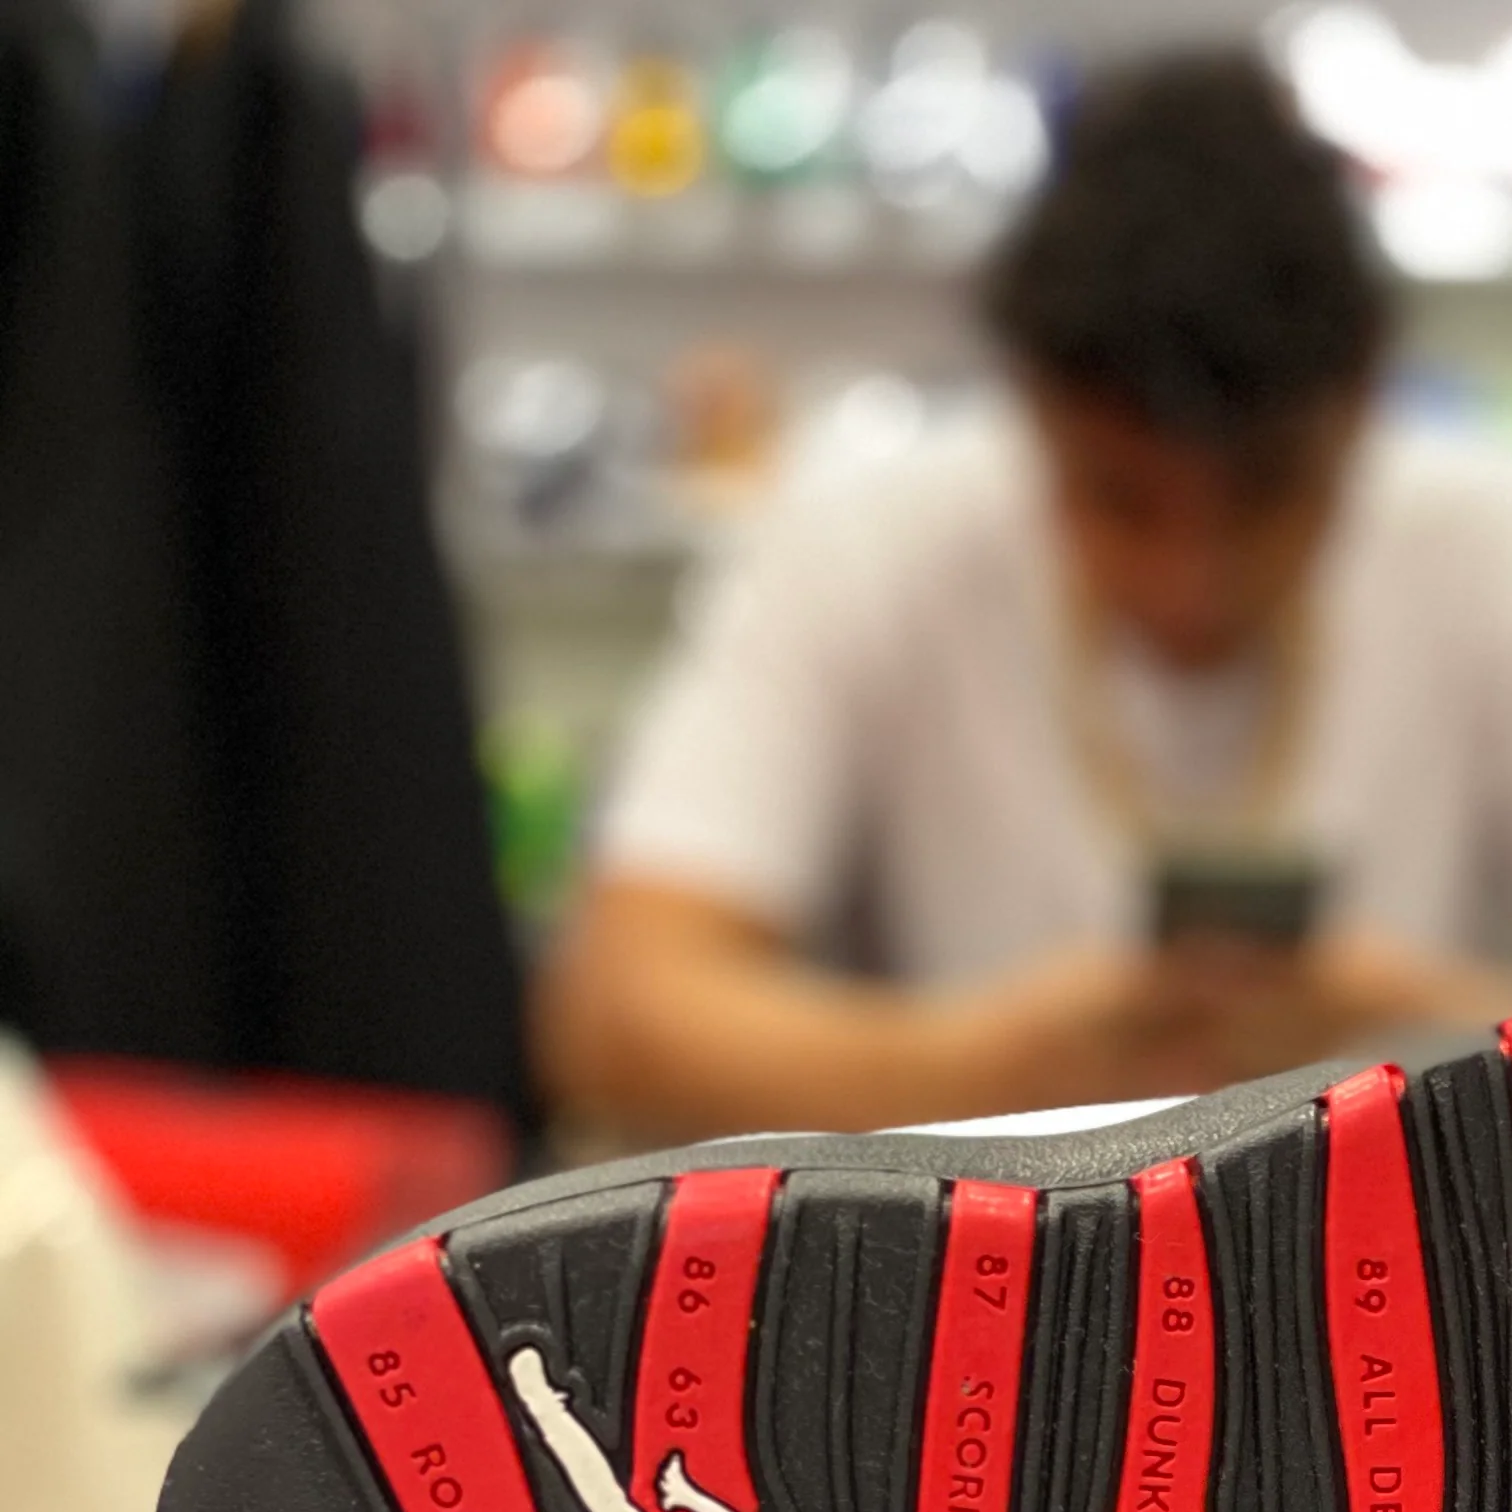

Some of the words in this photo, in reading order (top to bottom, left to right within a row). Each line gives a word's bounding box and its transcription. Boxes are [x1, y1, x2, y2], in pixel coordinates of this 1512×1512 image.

[677, 1256, 718, 1315] 86
[973, 1254, 1010, 1311] 87
[1160, 1276, 1195, 1335] 88
[1355, 1258, 1390, 1315] 89
[366, 1349, 417, 1411] 85
[665, 1366, 704, 1431] 63
[1360, 1353, 1397, 1437] ALL
